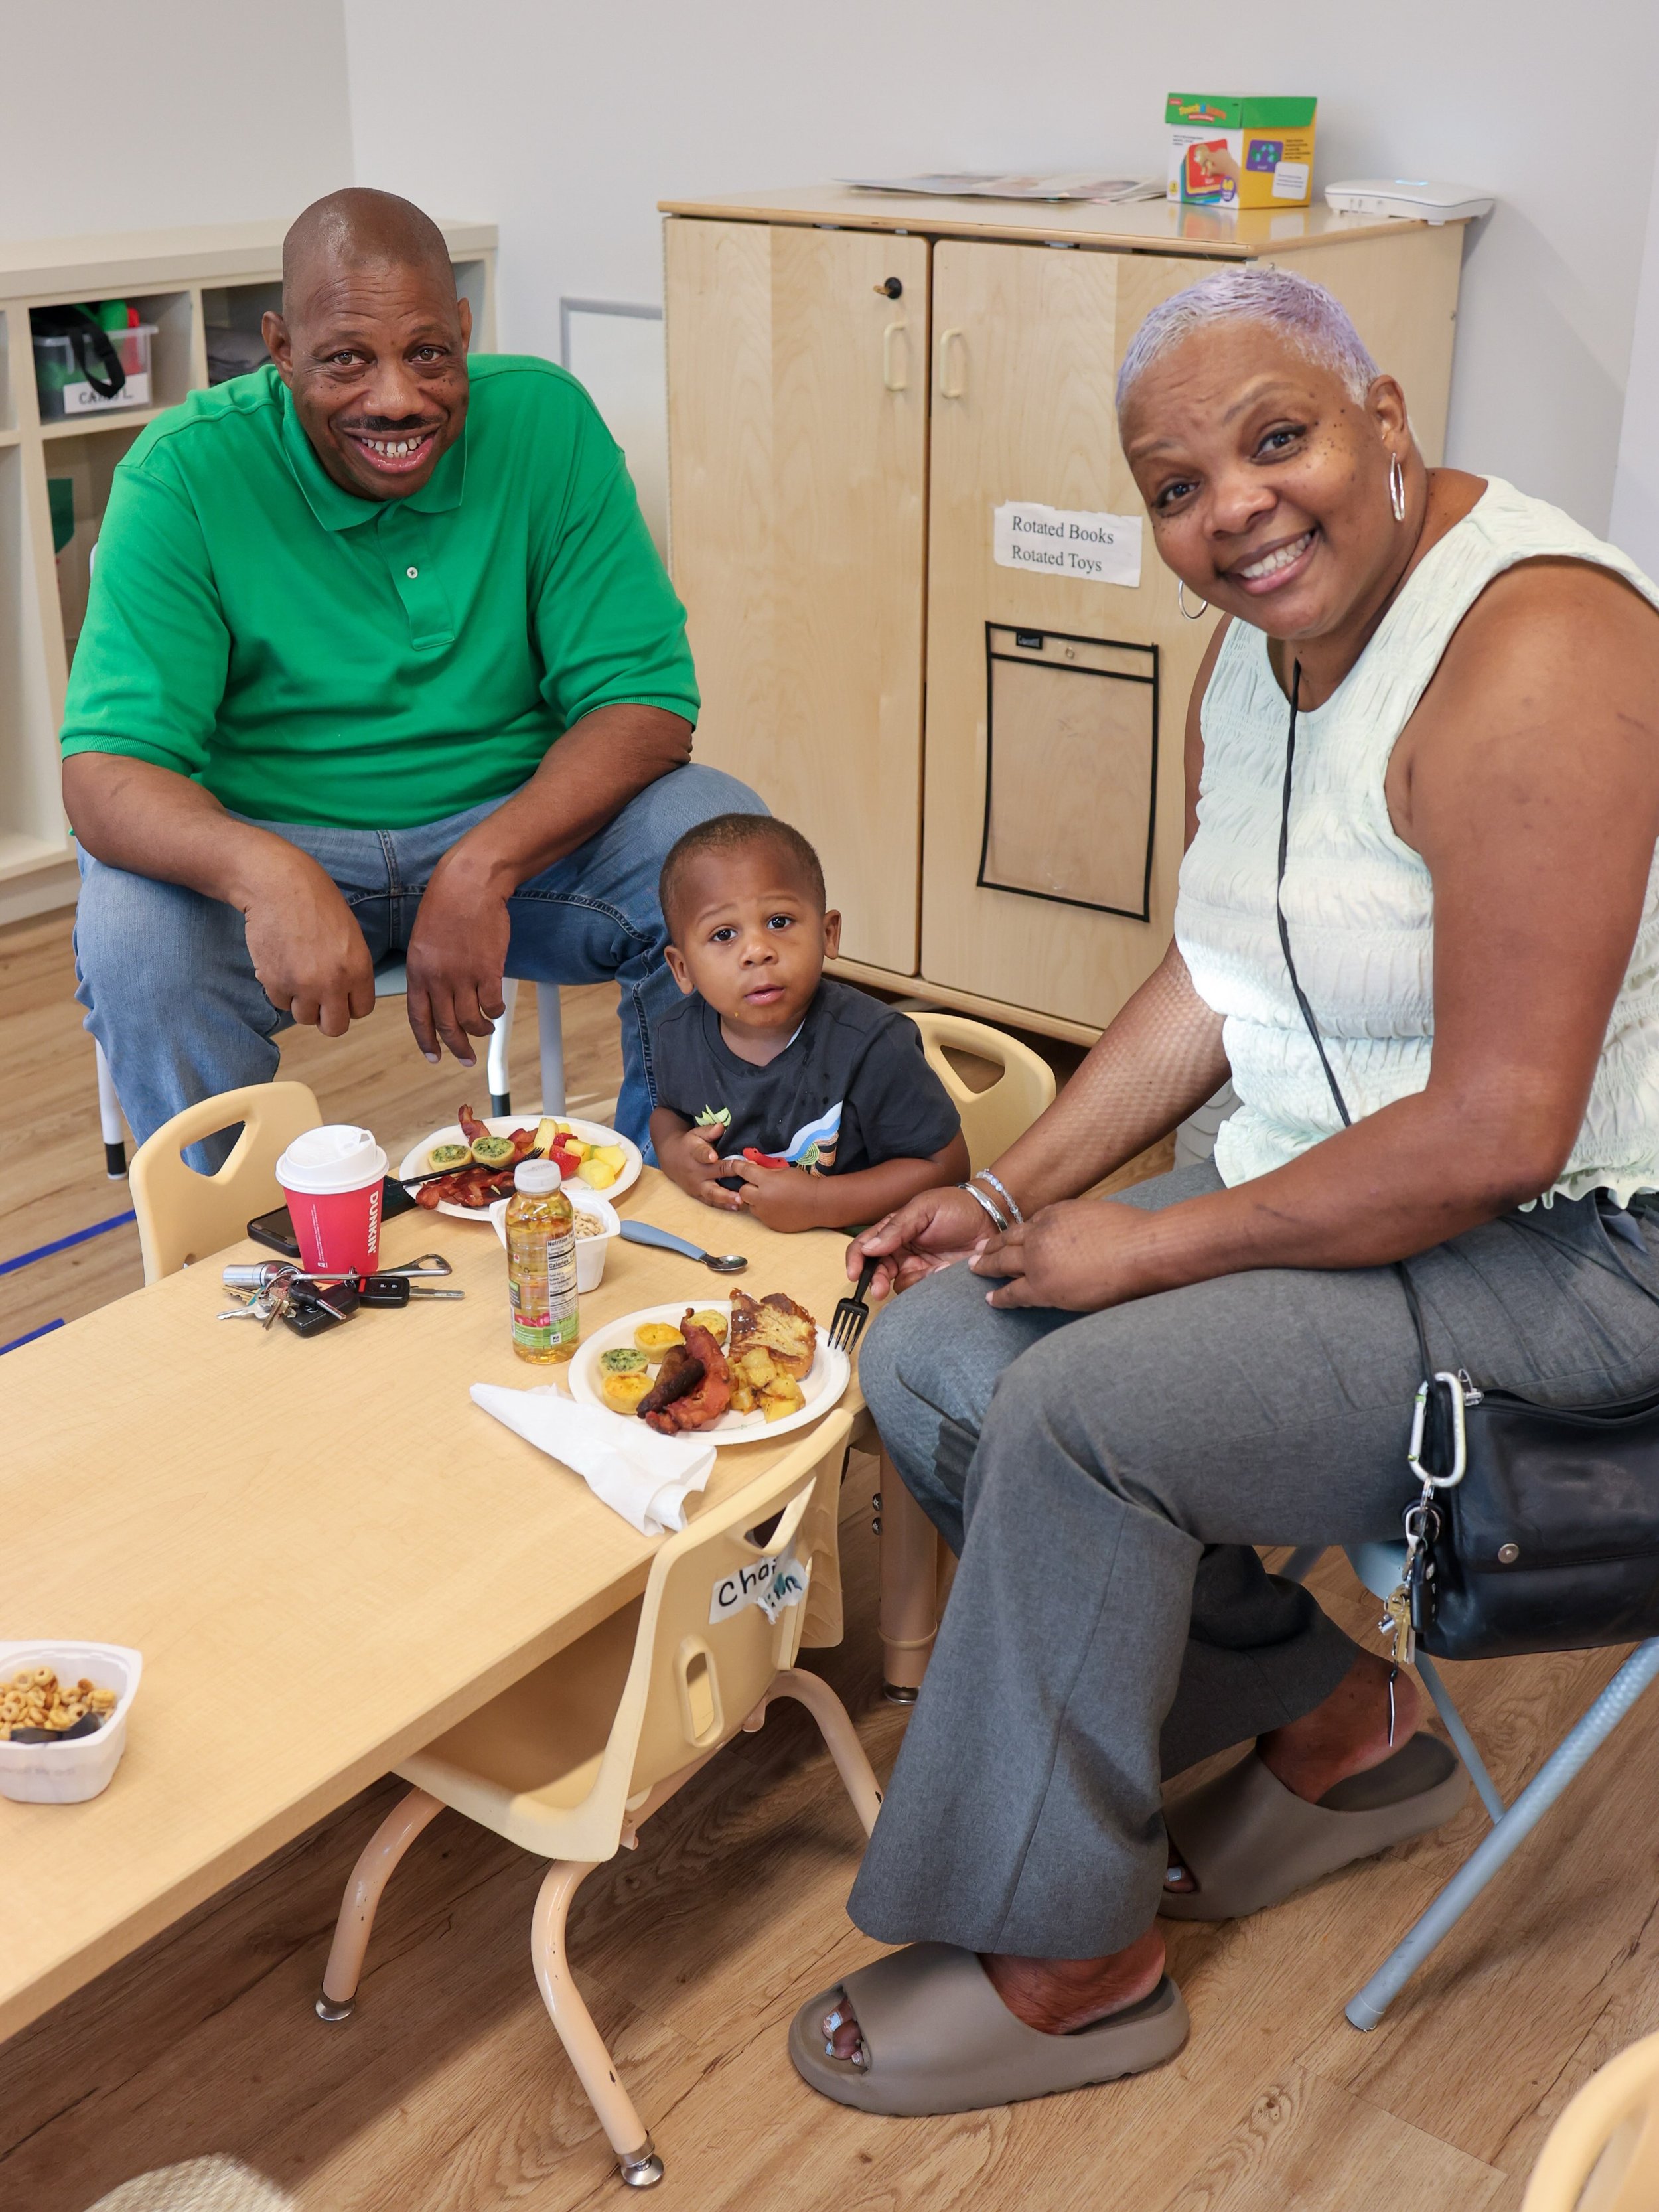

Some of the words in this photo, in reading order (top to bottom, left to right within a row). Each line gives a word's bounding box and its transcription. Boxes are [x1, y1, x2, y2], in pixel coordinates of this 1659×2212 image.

[1012, 515, 1064, 538] Rotated
[1068, 524, 1114, 544] Books
[1011, 544, 1064, 566] Rotated
[1068, 553, 1102, 574] Toys
[547, 1237, 568, 1246] Nutrition
[548, 1259, 569, 1268] Calories
